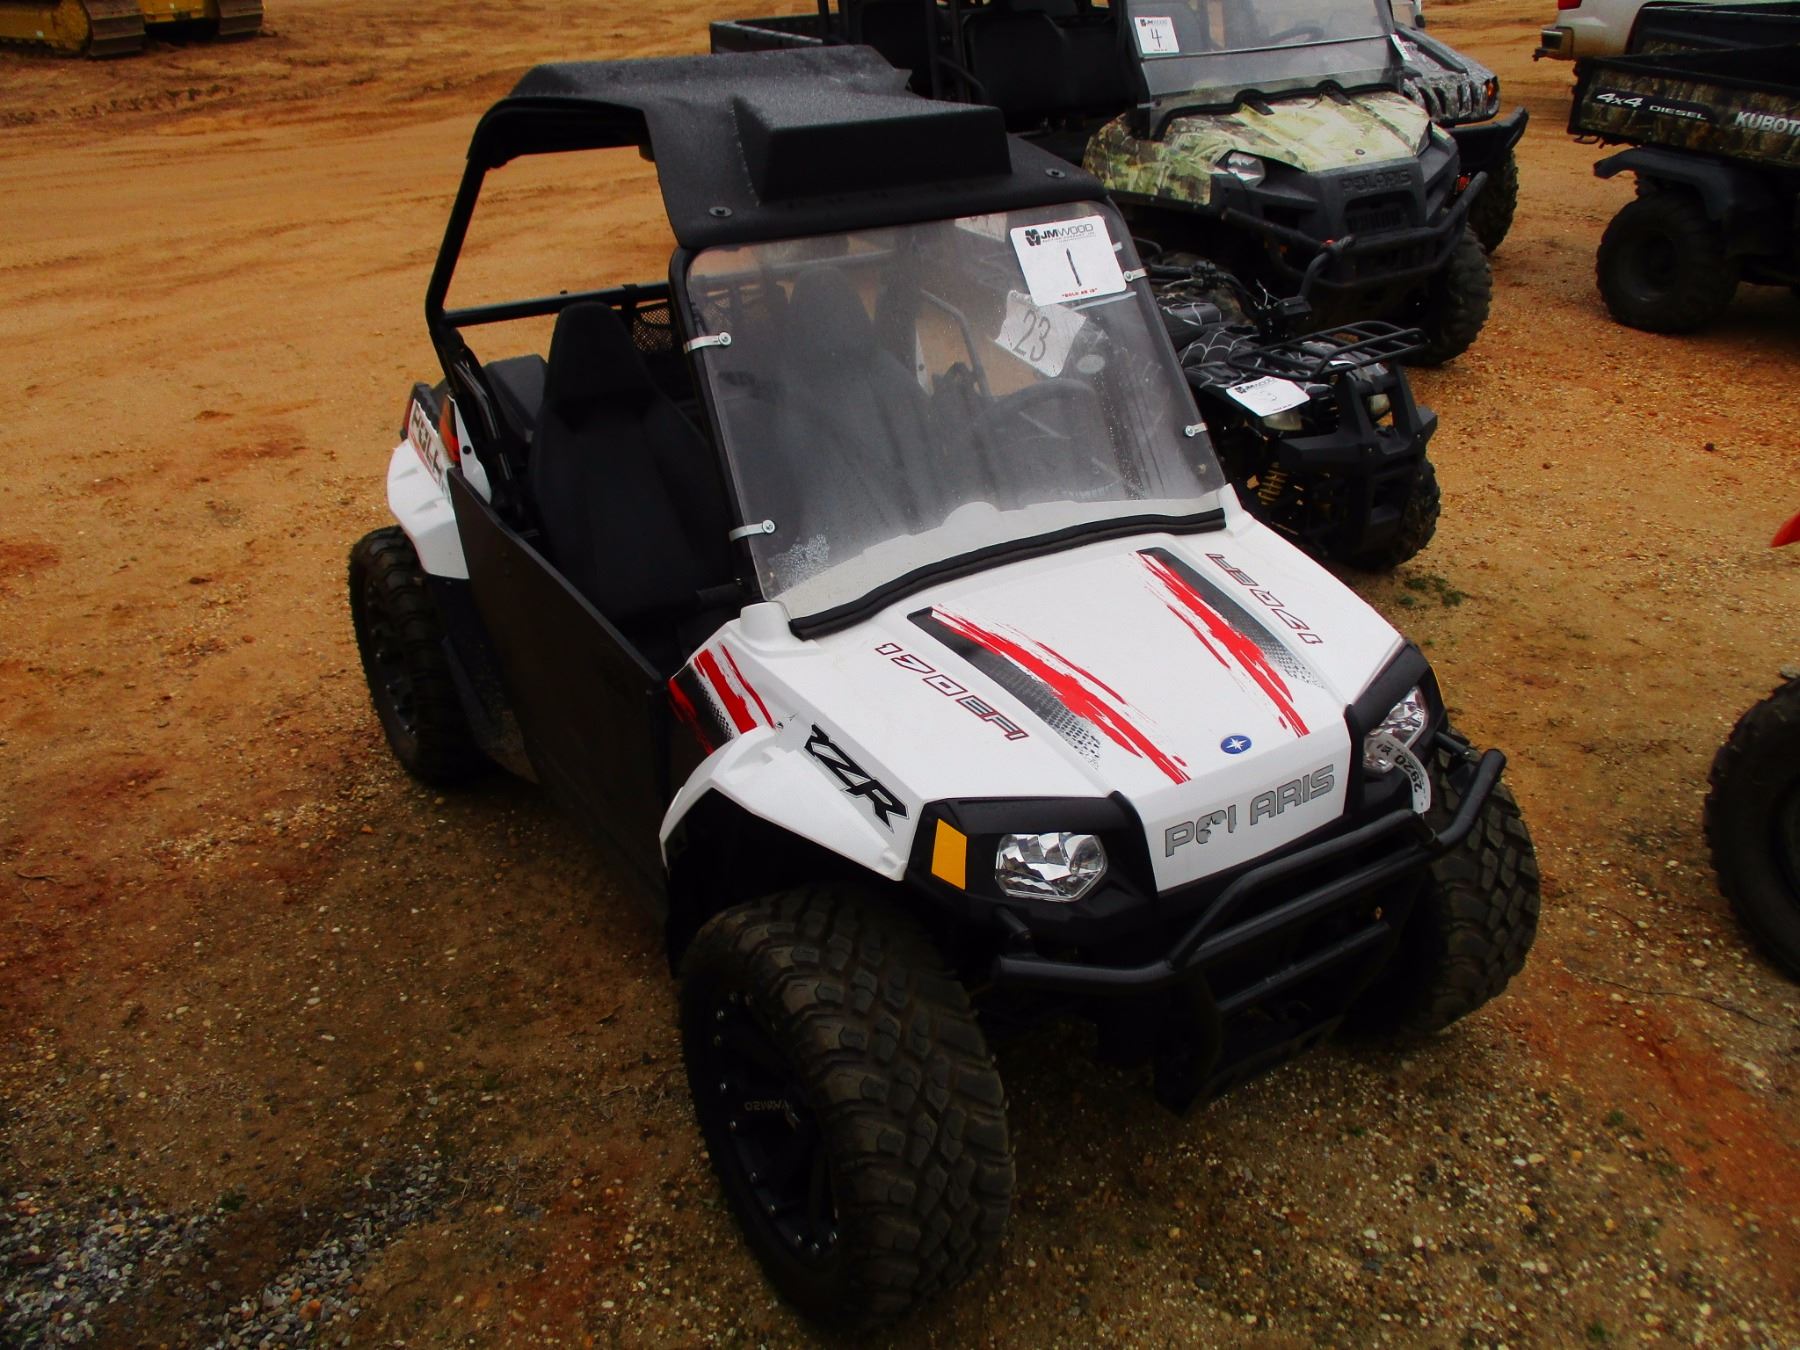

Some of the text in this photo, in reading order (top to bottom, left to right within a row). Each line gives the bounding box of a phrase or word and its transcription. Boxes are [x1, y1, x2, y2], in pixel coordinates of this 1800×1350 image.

[1150, 27, 1163, 49] 4
[1596, 92, 1709, 121] 4x4 DIESEL
[1342, 168, 1412, 193] POLARIS
[1040, 223, 1094, 239] JMWOOD
[1066, 247, 1082, 287] 1
[1012, 310, 1051, 362] 23
